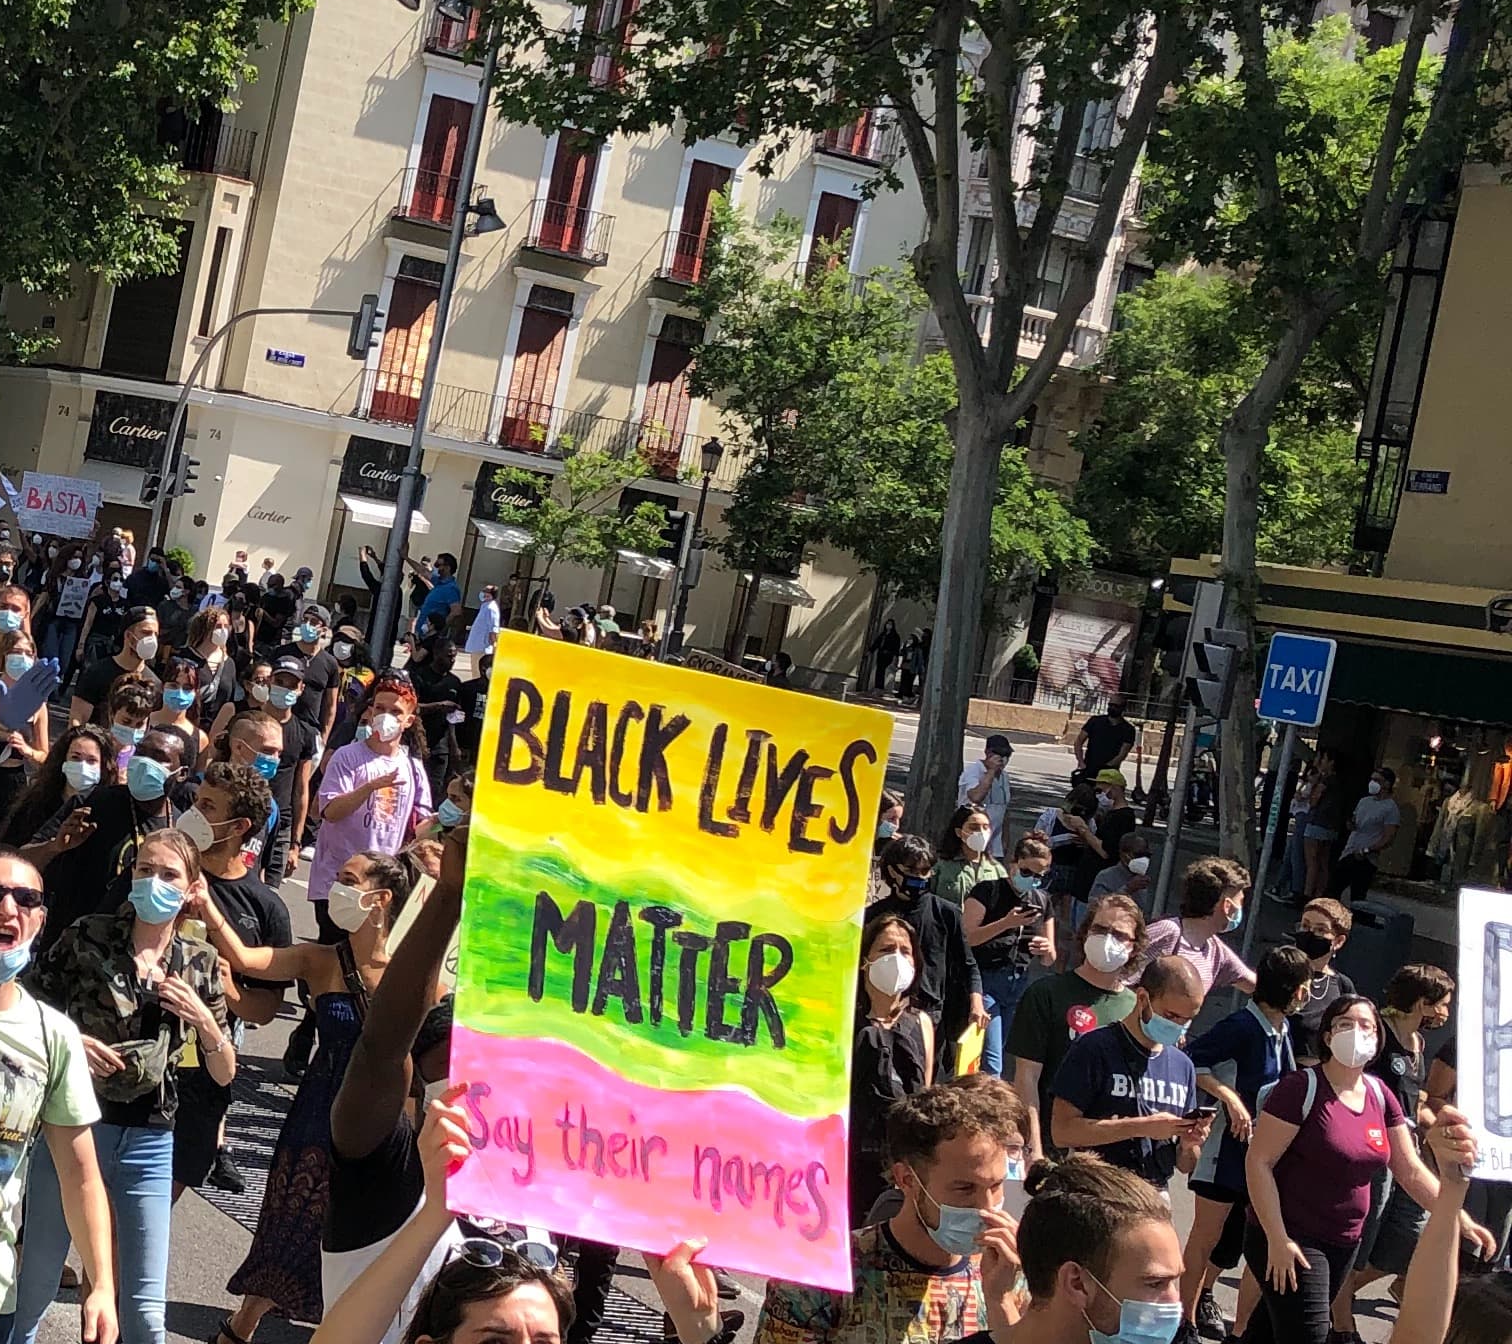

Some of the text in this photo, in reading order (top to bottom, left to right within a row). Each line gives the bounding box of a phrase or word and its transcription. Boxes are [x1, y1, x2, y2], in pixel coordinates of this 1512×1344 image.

[57, 405, 70, 417] 74
[109, 416, 167, 441] Cartier
[209, 428, 222, 440] 74
[359, 461, 403, 483] Cartier
[26, 487, 87, 519] BASTA
[490, 487, 533, 507] Cartier
[247, 505, 292, 525] Cartier
[1270, 663, 1324, 696] TAXI
[493, 678, 877, 854] BLACK LIVES
[527, 891, 794, 1049] MATTER
[467, 1081, 829, 1242] Say their names
